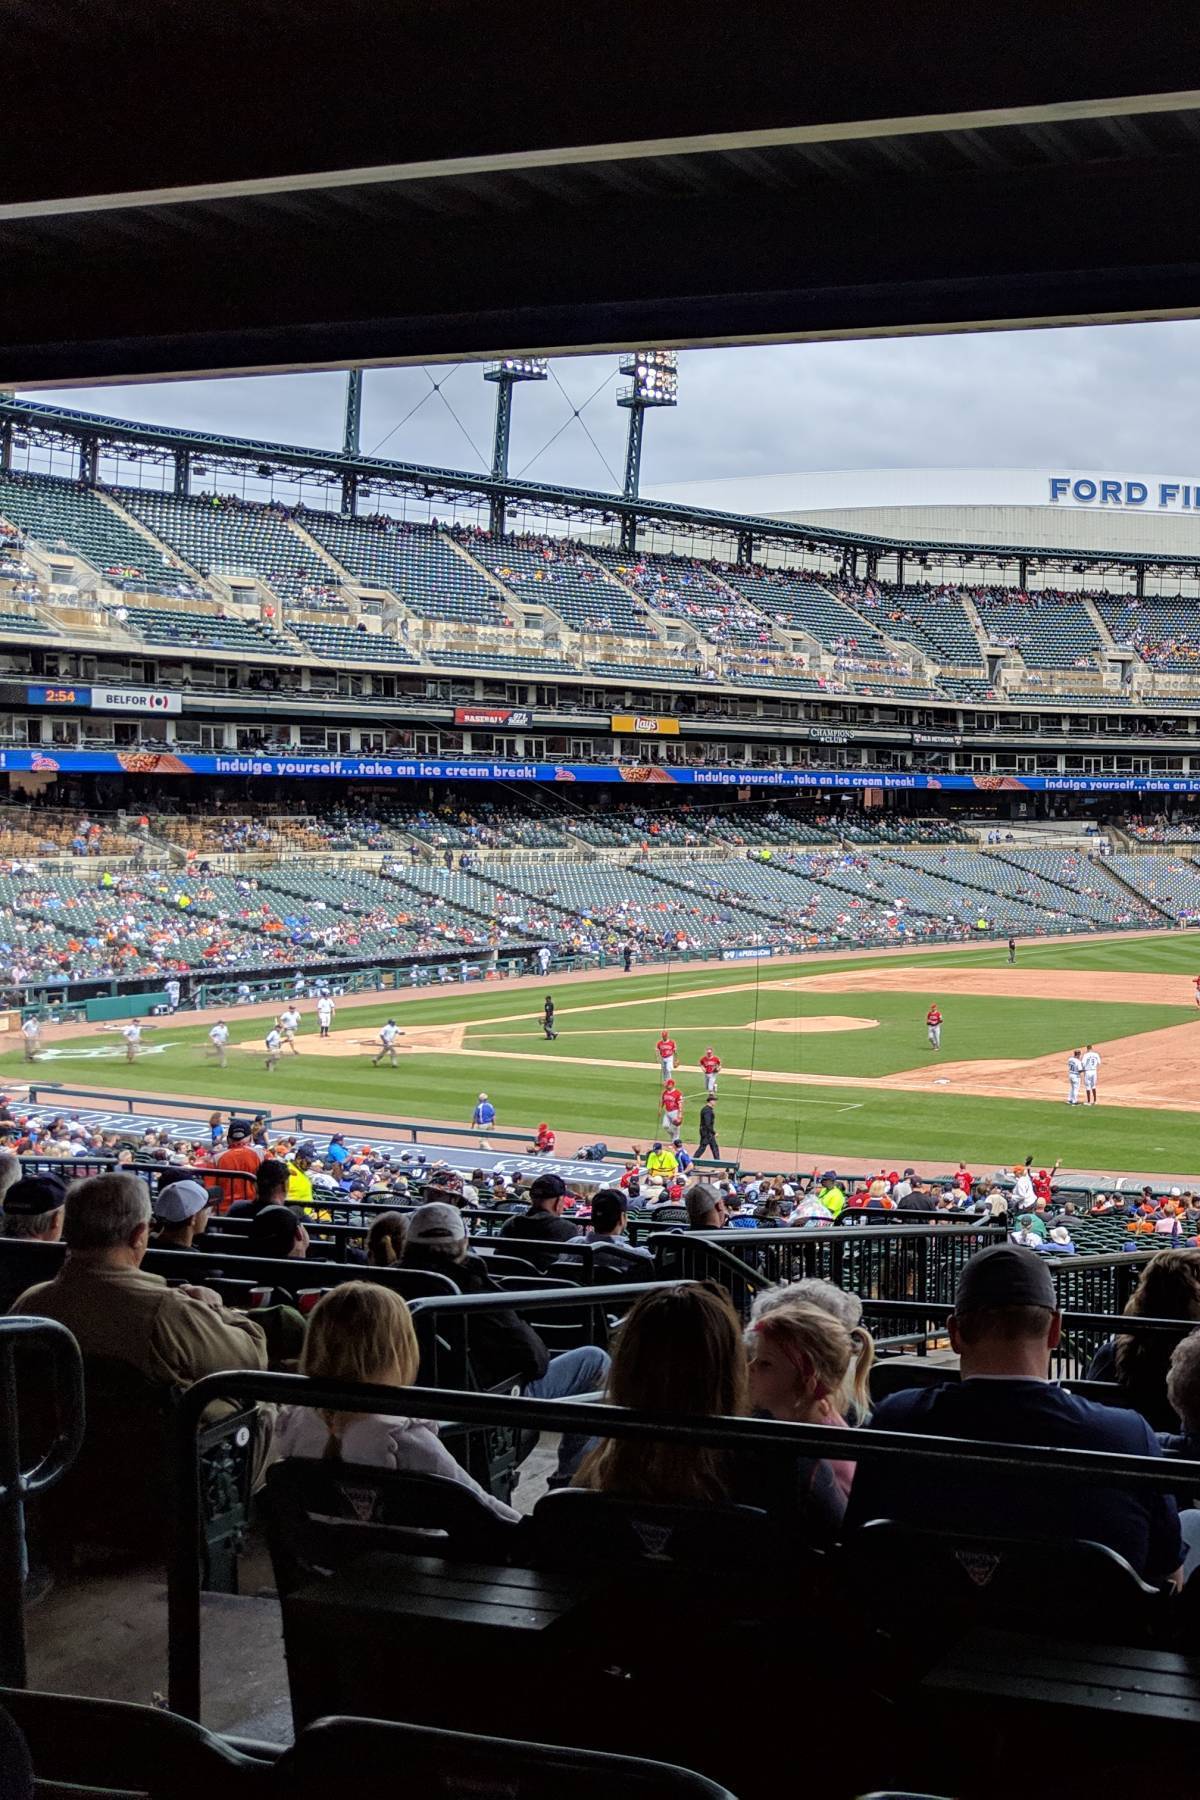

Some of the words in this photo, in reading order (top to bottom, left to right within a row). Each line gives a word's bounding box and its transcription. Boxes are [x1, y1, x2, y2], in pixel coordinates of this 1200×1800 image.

[1049, 478, 1149, 505] FORD
[46, 690, 75, 702] 2:54
[106, 695, 146, 705] BELFOR
[811, 728, 855, 738] CHAMPIONS
[216, 758, 272, 774] indulge
[397, 766, 415, 775] an
[420, 763, 441, 776] ice
[446, 767, 489, 777] cream
[493, 765, 537, 778] break!
[694, 771, 736, 783] indulge
[835, 775, 849, 785] ice
[853, 778, 882, 786] cream
[885, 777, 915, 786] break!
[1045, 779, 1086, 790] indulge
